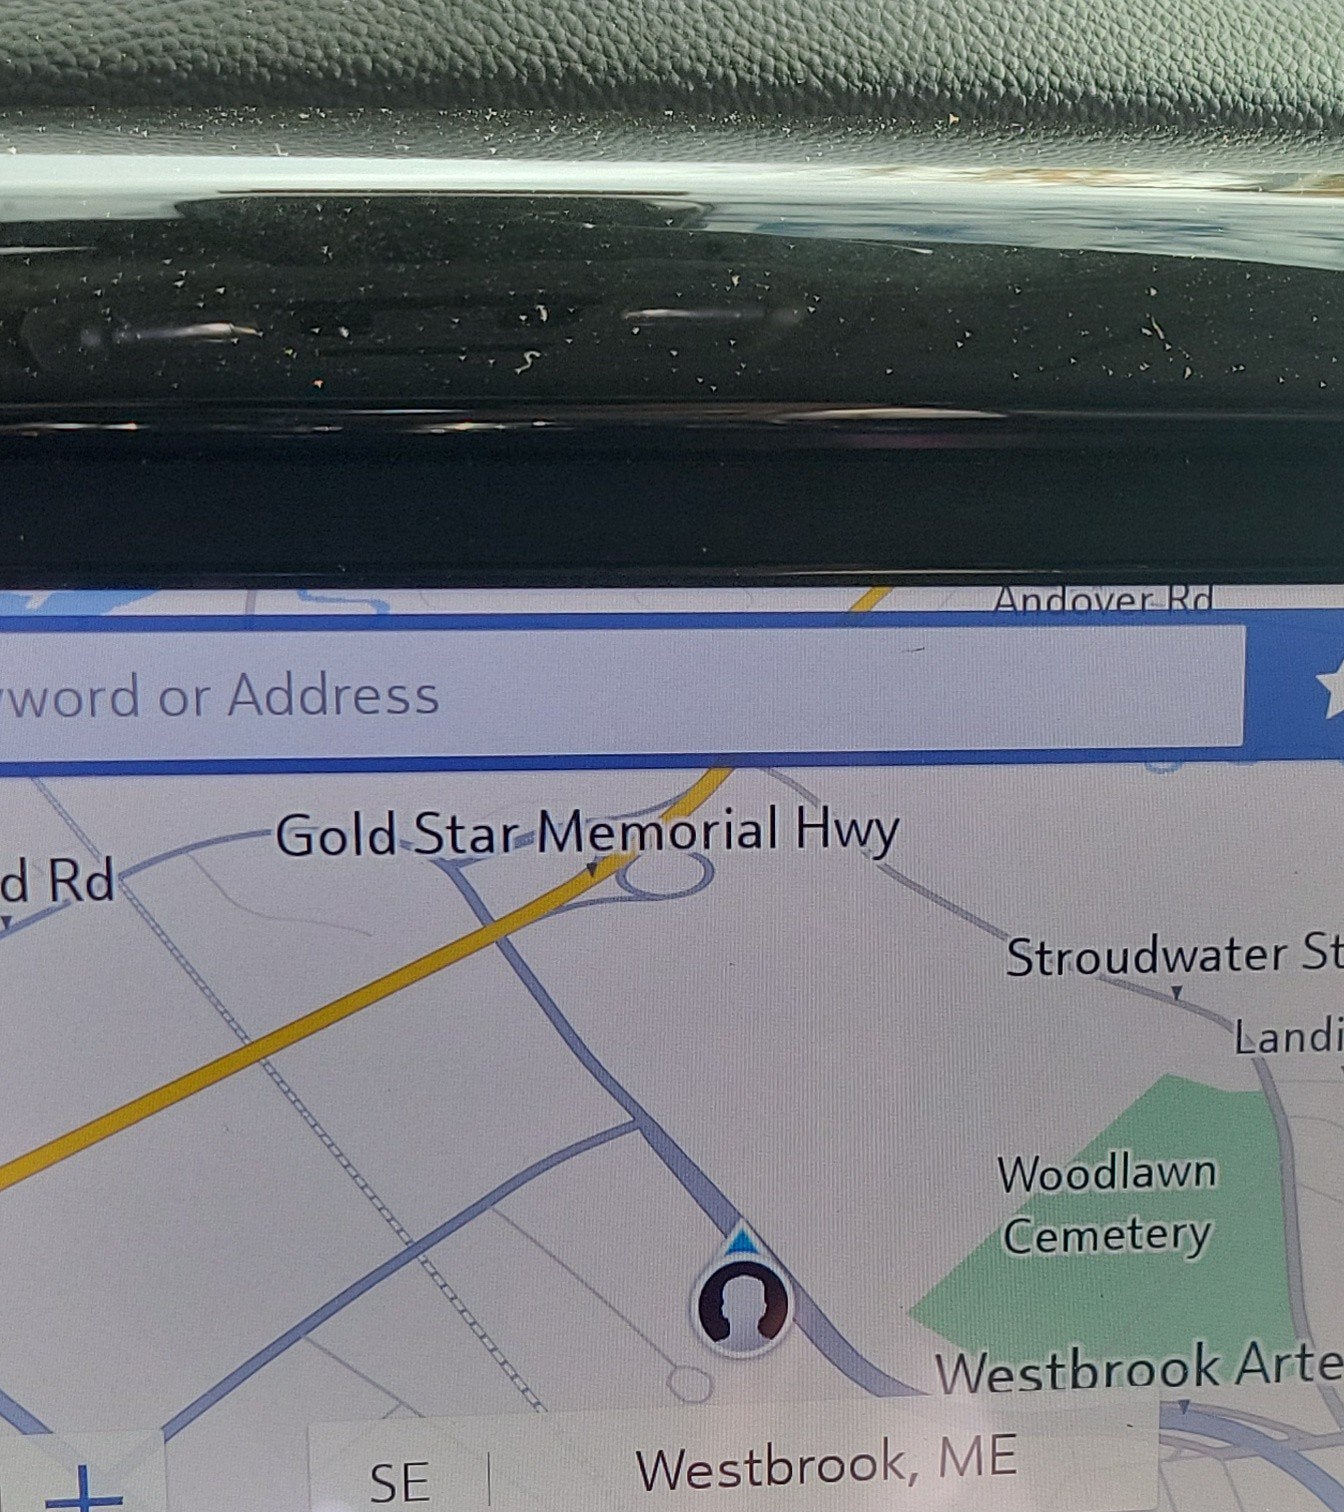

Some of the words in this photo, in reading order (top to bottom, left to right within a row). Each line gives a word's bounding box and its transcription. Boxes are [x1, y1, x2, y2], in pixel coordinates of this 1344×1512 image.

[993, 585, 1154, 614] Andover
[1168, 585, 1215, 612] Rd
[159, 684, 211, 716] or
[228, 672, 440, 716] Address
[276, 812, 396, 856] Gold
[414, 811, 517, 854] Star
[538, 806, 777, 853] Memorial
[797, 806, 900, 860] Hwy
[50, 856, 115, 901] Rd
[1007, 934, 1287, 977] Stroudwater
[997, 1152, 1217, 1194] Woodlawn
[1003, 1218, 1212, 1260] Cemetery
[936, 1342, 1220, 1394] Westbrook
[370, 1462, 431, 1503] SE
[636, 1437, 918, 1490] Westbrook,
[939, 1433, 1018, 1477] ME
